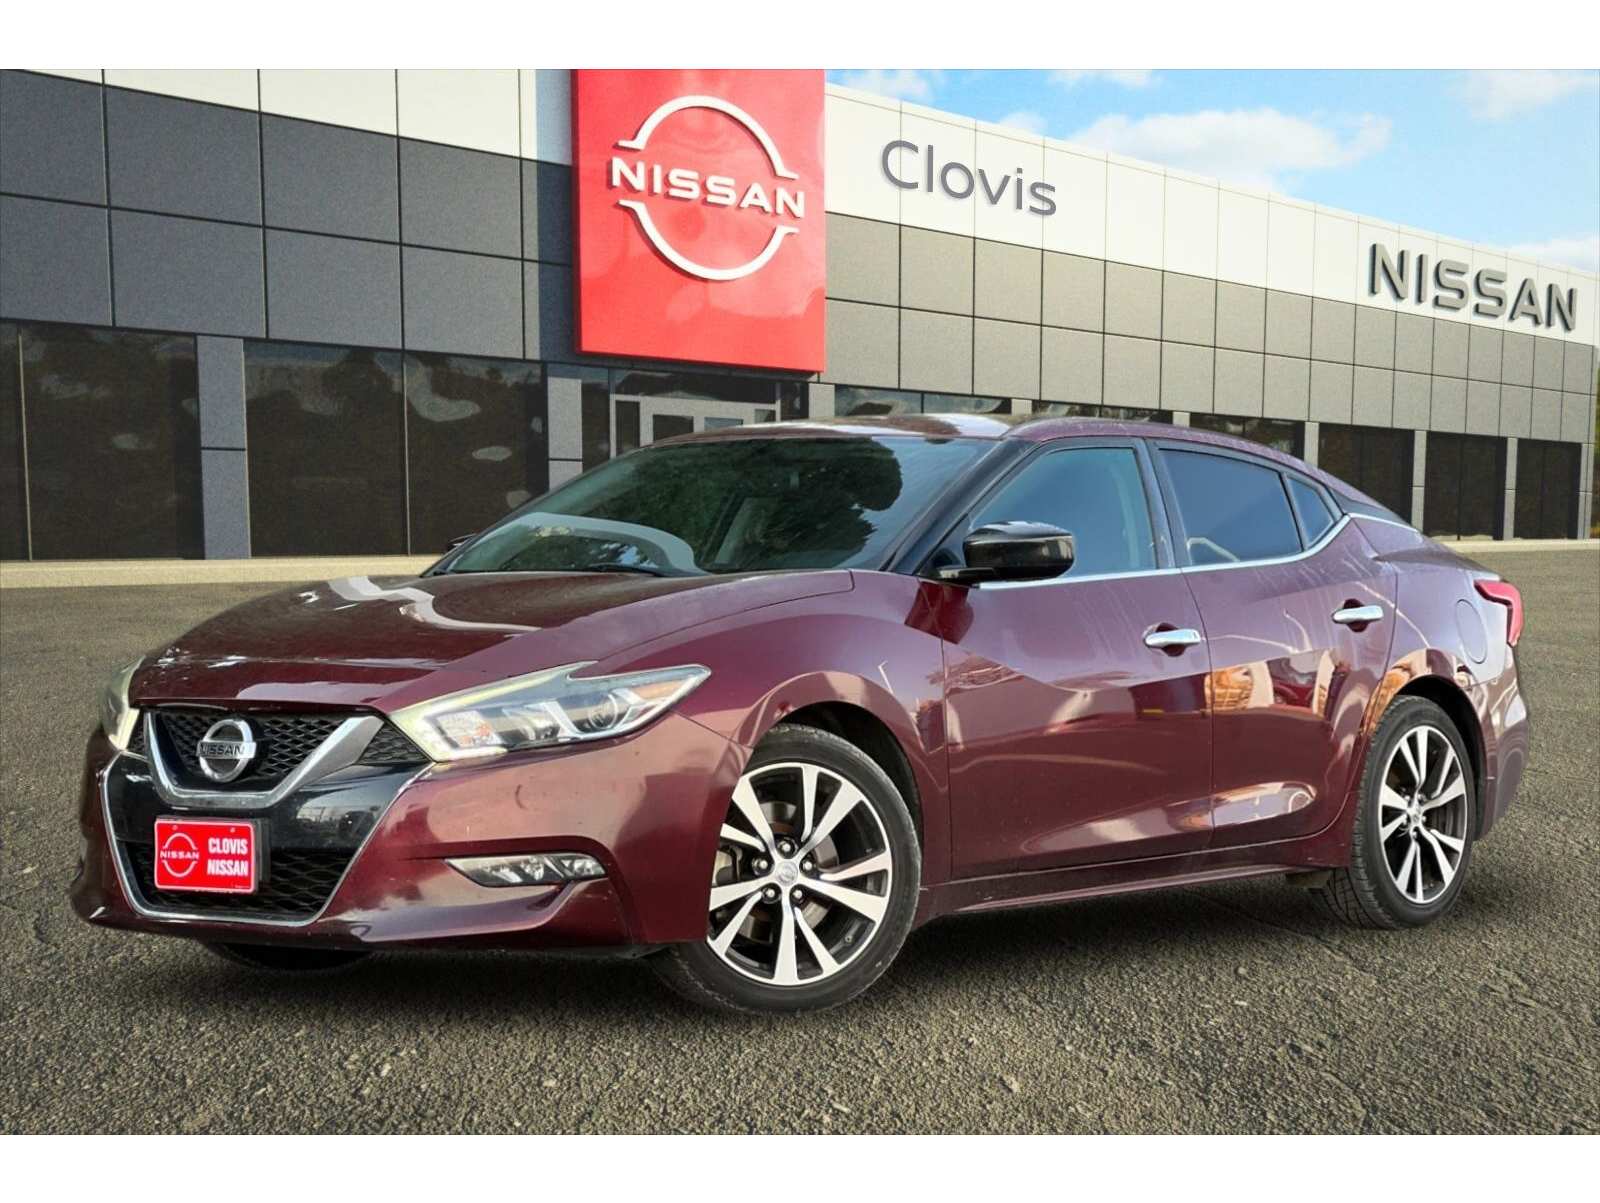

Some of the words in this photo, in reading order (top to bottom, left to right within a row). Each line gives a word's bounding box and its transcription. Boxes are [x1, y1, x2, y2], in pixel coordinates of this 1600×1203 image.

[882, 140, 1057, 216] Clovis
[611, 156, 805, 218] NISSAN
[1369, 243, 1577, 331] NISSAN
[200, 742, 244, 756] NISSAN
[208, 838, 248, 854] CLOVIS
[160, 851, 200, 860] NISSAN
[207, 859, 249, 876] NISSAN
